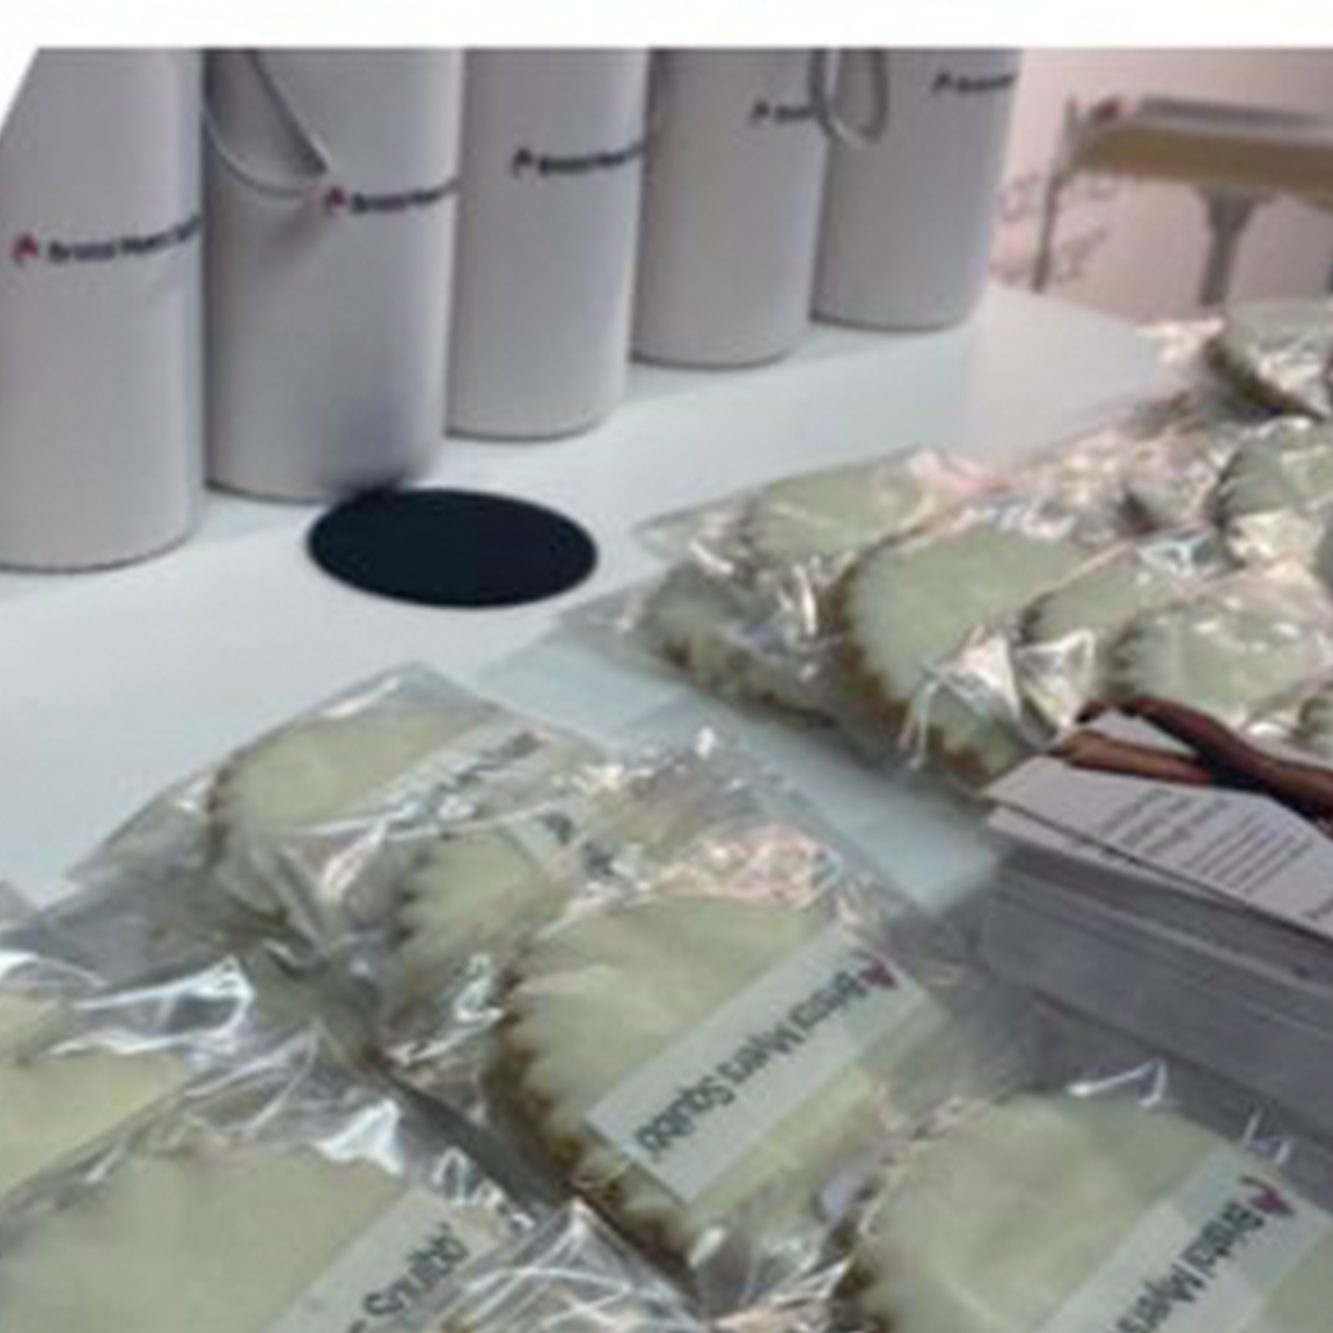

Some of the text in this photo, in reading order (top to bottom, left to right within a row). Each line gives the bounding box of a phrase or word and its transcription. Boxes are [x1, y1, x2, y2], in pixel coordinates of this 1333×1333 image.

[635, 970, 868, 1163] Bristol Myers Squibb
[1179, 1200, 1265, 1282] Bristol
